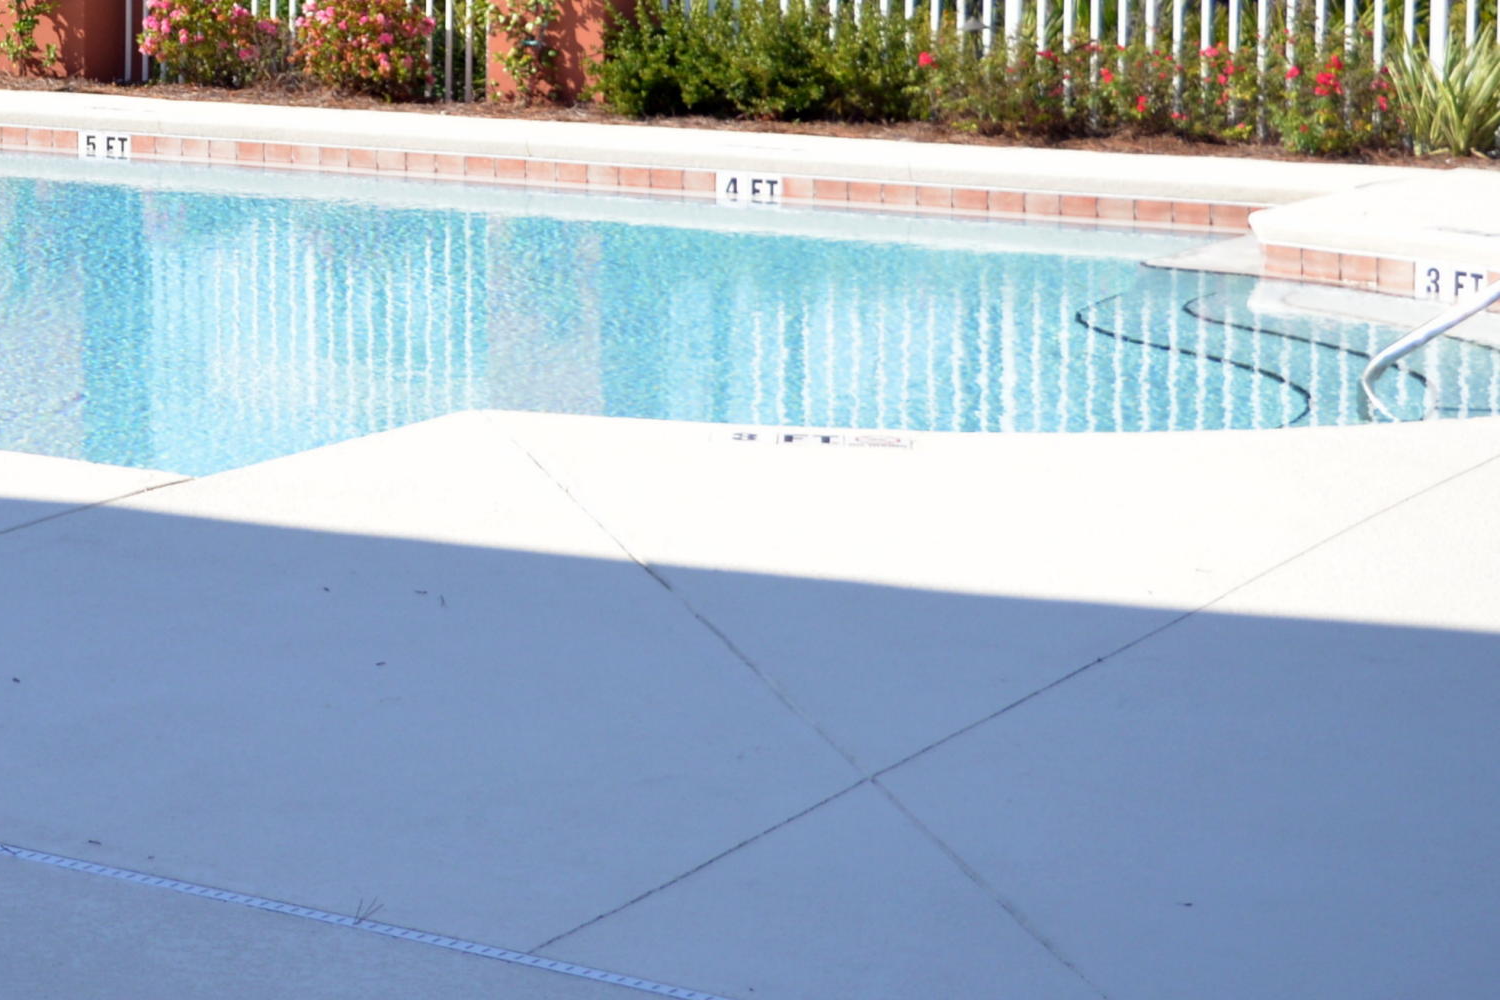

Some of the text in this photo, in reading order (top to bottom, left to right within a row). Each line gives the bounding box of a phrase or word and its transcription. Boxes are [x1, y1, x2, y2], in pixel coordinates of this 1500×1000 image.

[86, 135, 128, 154] 5 FT
[726, 177, 779, 198] 4 FT
[1426, 267, 1484, 296] 3 FT
